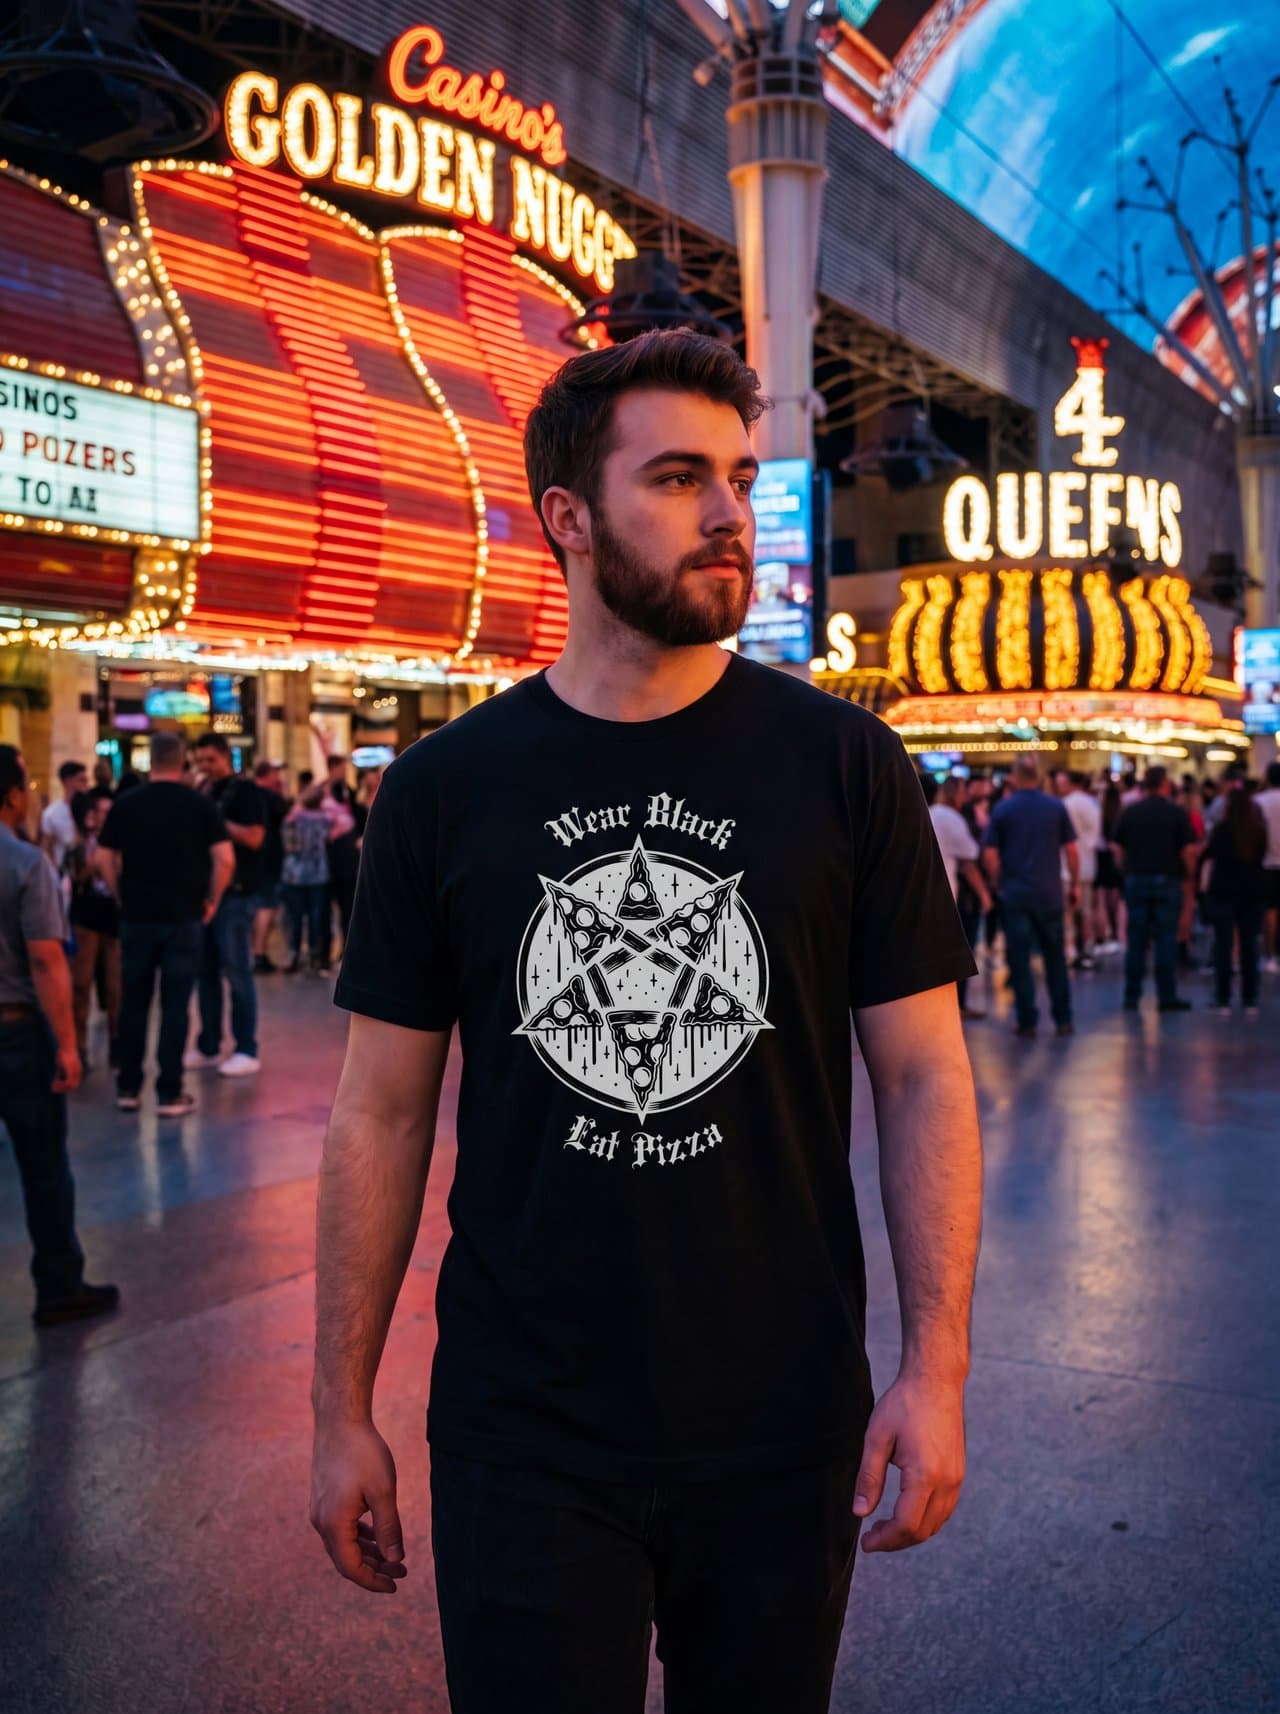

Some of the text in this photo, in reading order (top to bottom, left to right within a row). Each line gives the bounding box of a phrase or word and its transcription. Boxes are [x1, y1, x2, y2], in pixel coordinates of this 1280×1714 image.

[387, 23, 568, 166] Casino's
[225, 71, 496, 226] GOLDEN
[1054, 367, 1126, 467] 4
[17, 477, 52, 505] TO
[544, 791, 737, 851] Wear Black
[563, 1115, 723, 1170] Eat Pizza
